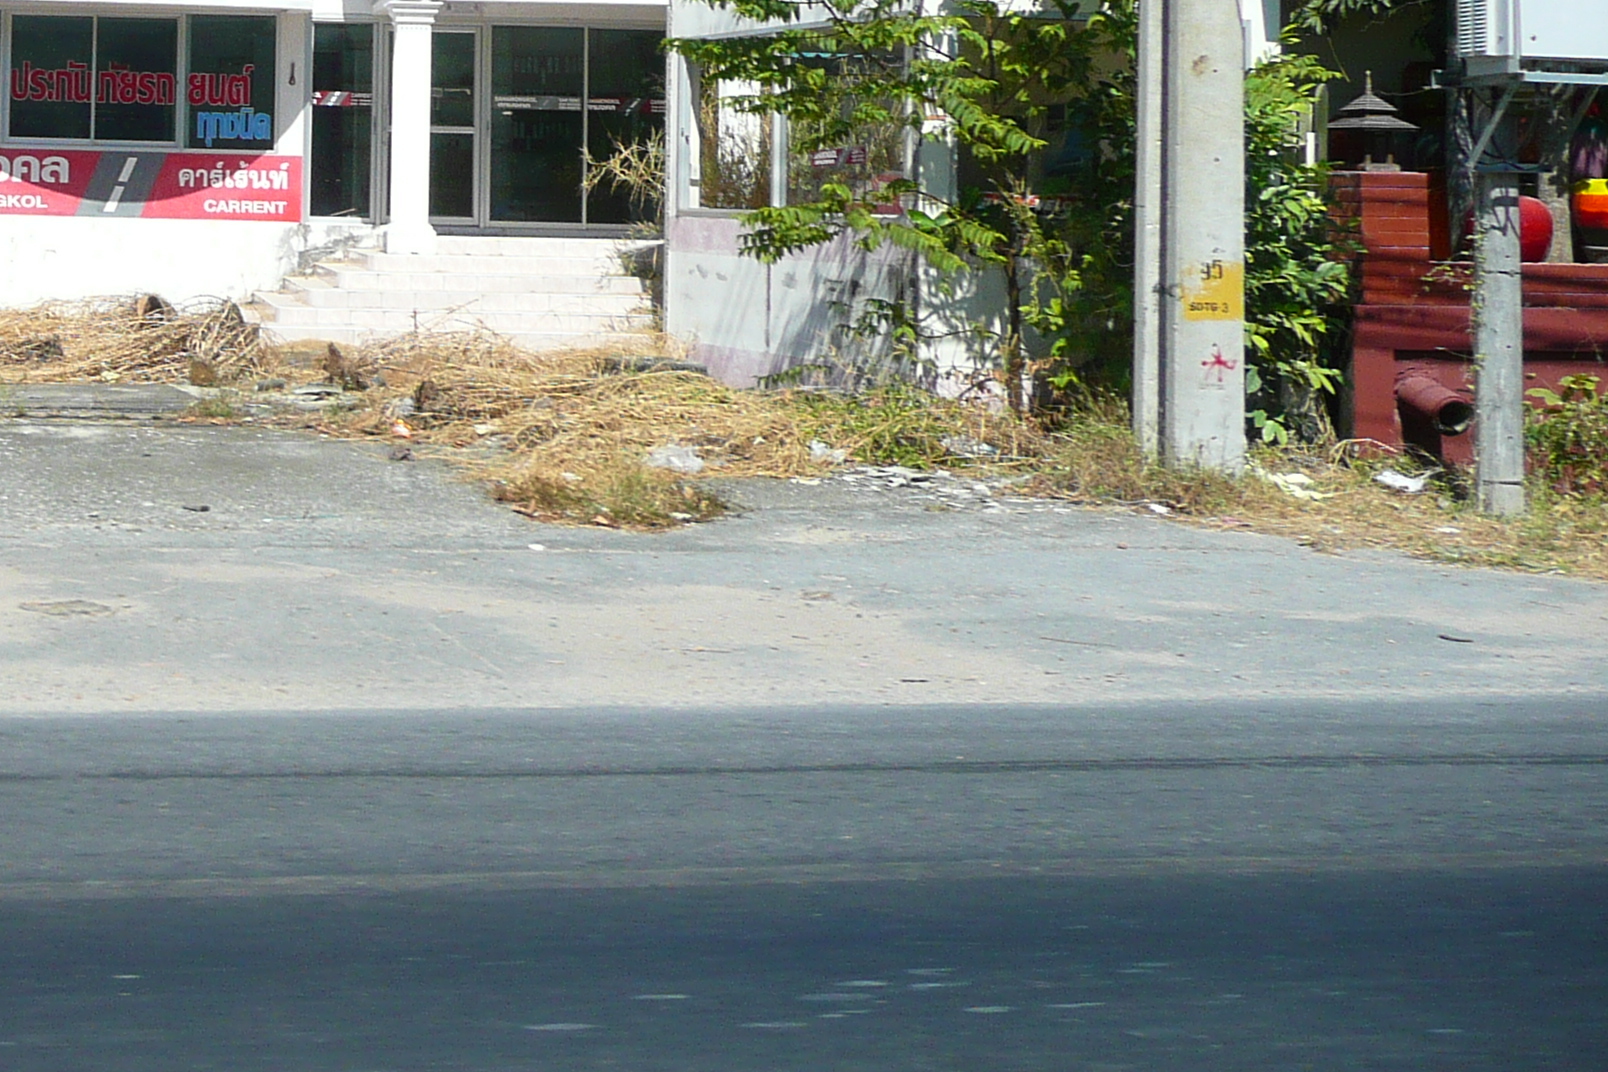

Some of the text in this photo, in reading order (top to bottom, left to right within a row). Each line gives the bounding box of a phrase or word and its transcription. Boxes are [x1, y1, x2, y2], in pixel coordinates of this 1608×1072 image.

[196, 107, 272, 148] ทุกชนิด
[178, 160, 290, 190] คาร์เร้นท์
[203, 199, 288, 214] CARRENT
